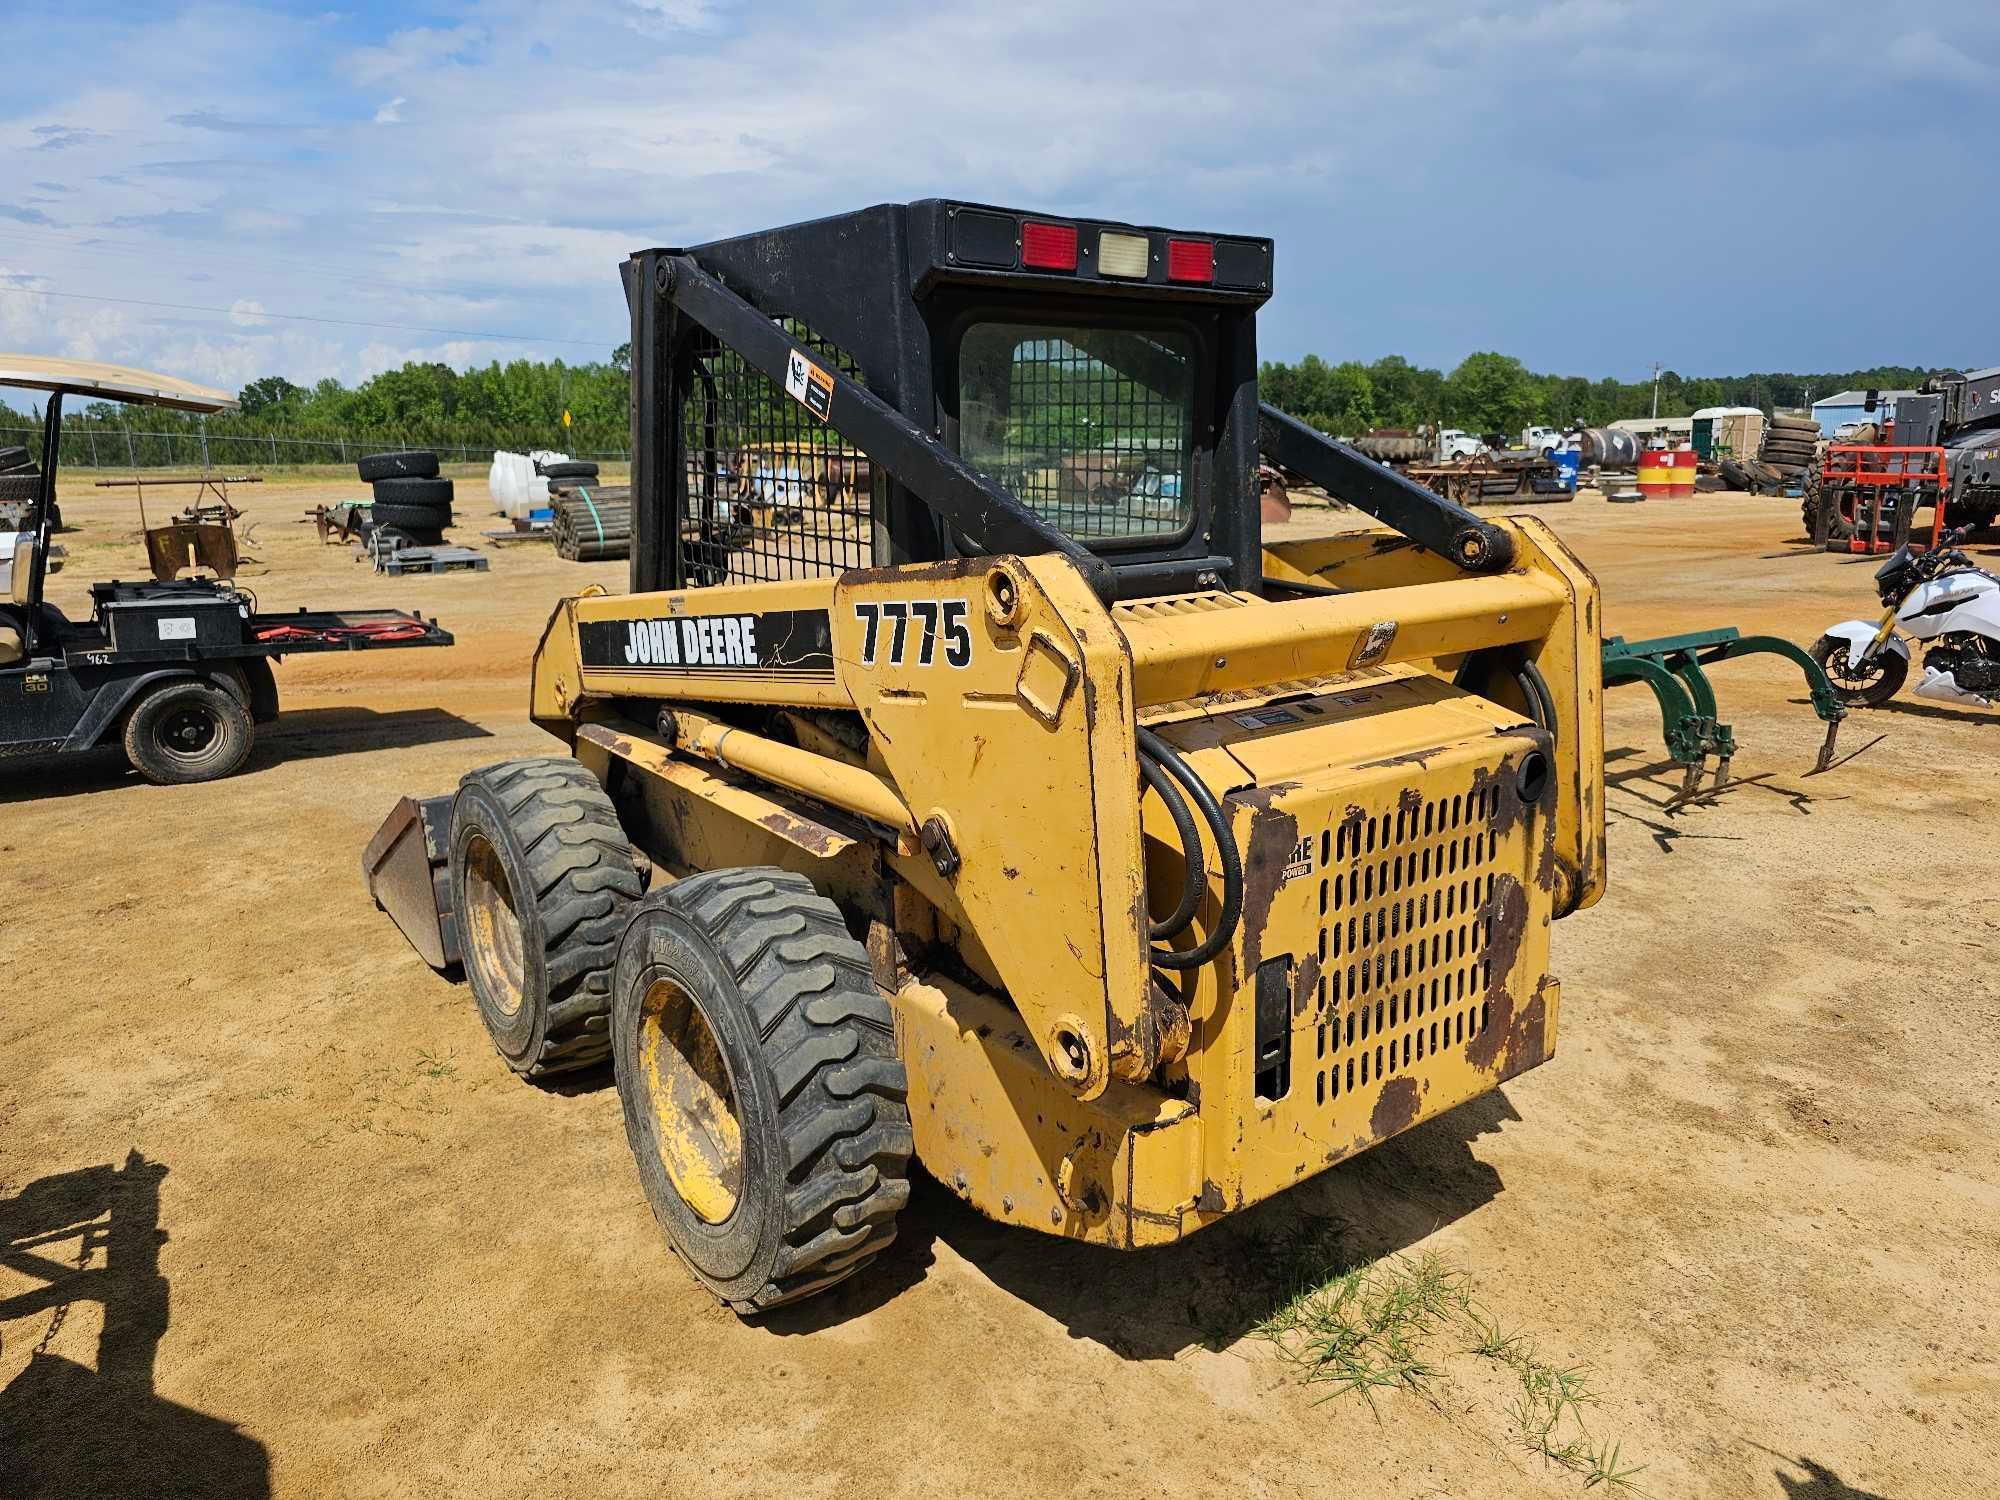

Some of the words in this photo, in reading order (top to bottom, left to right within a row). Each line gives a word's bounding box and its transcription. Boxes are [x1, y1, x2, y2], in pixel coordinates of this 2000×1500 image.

[624, 620, 679, 665] JOHN
[682, 617, 758, 665] DEERE
[854, 598, 972, 670] 7775
[1281, 865, 1308, 880] POWER
